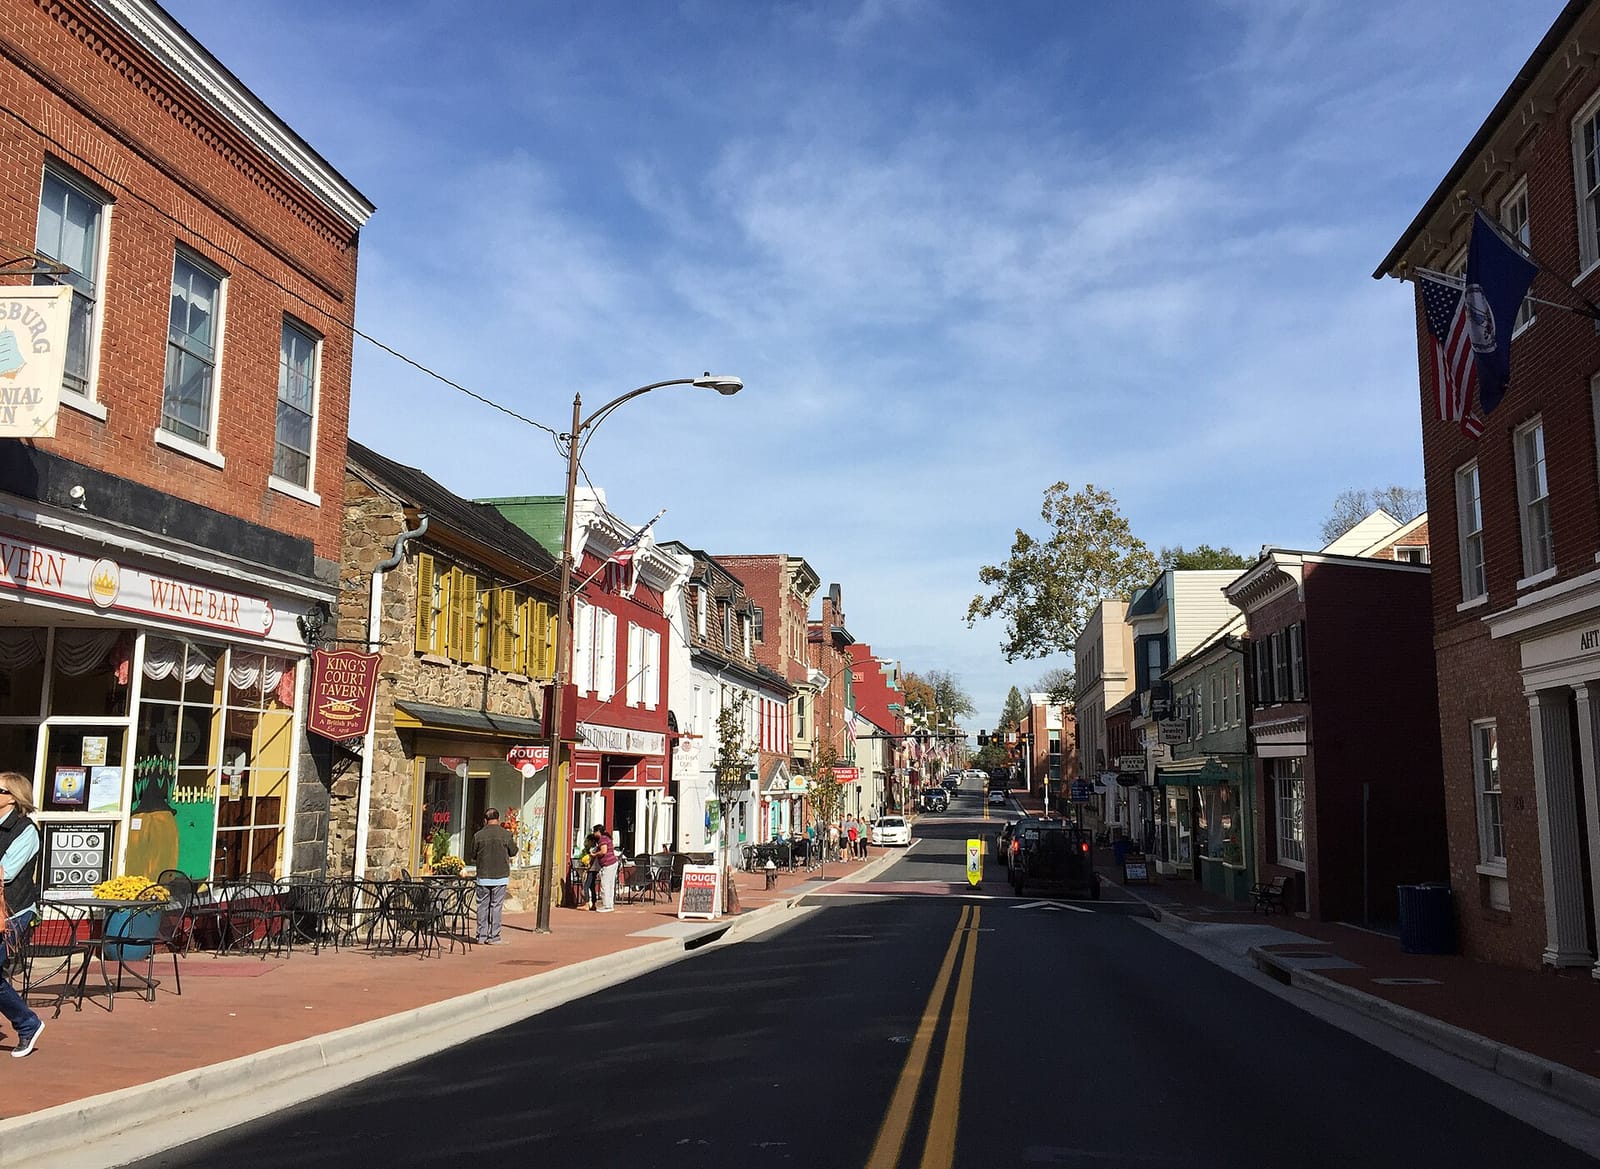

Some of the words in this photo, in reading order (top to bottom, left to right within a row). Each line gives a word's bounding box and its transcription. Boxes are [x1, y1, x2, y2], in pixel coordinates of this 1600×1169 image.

[0, 386, 43, 405] NIAL
[0, 405, 17, 424] N
[0, 542, 66, 588] VERN
[150, 578, 204, 616] WINE
[207, 592, 241, 627] BAR
[1580, 629, 1600, 650] AHT
[326, 657, 367, 672] KING'S
[324, 670, 367, 685] COURT
[320, 683, 367, 698] TAVERN
[509, 749, 549, 759] ROUGE
[56, 834, 100, 849] UDO
[55, 851, 100, 866] VOO
[53, 869, 100, 884] DOO
[685, 873, 716, 882] ROUGE
